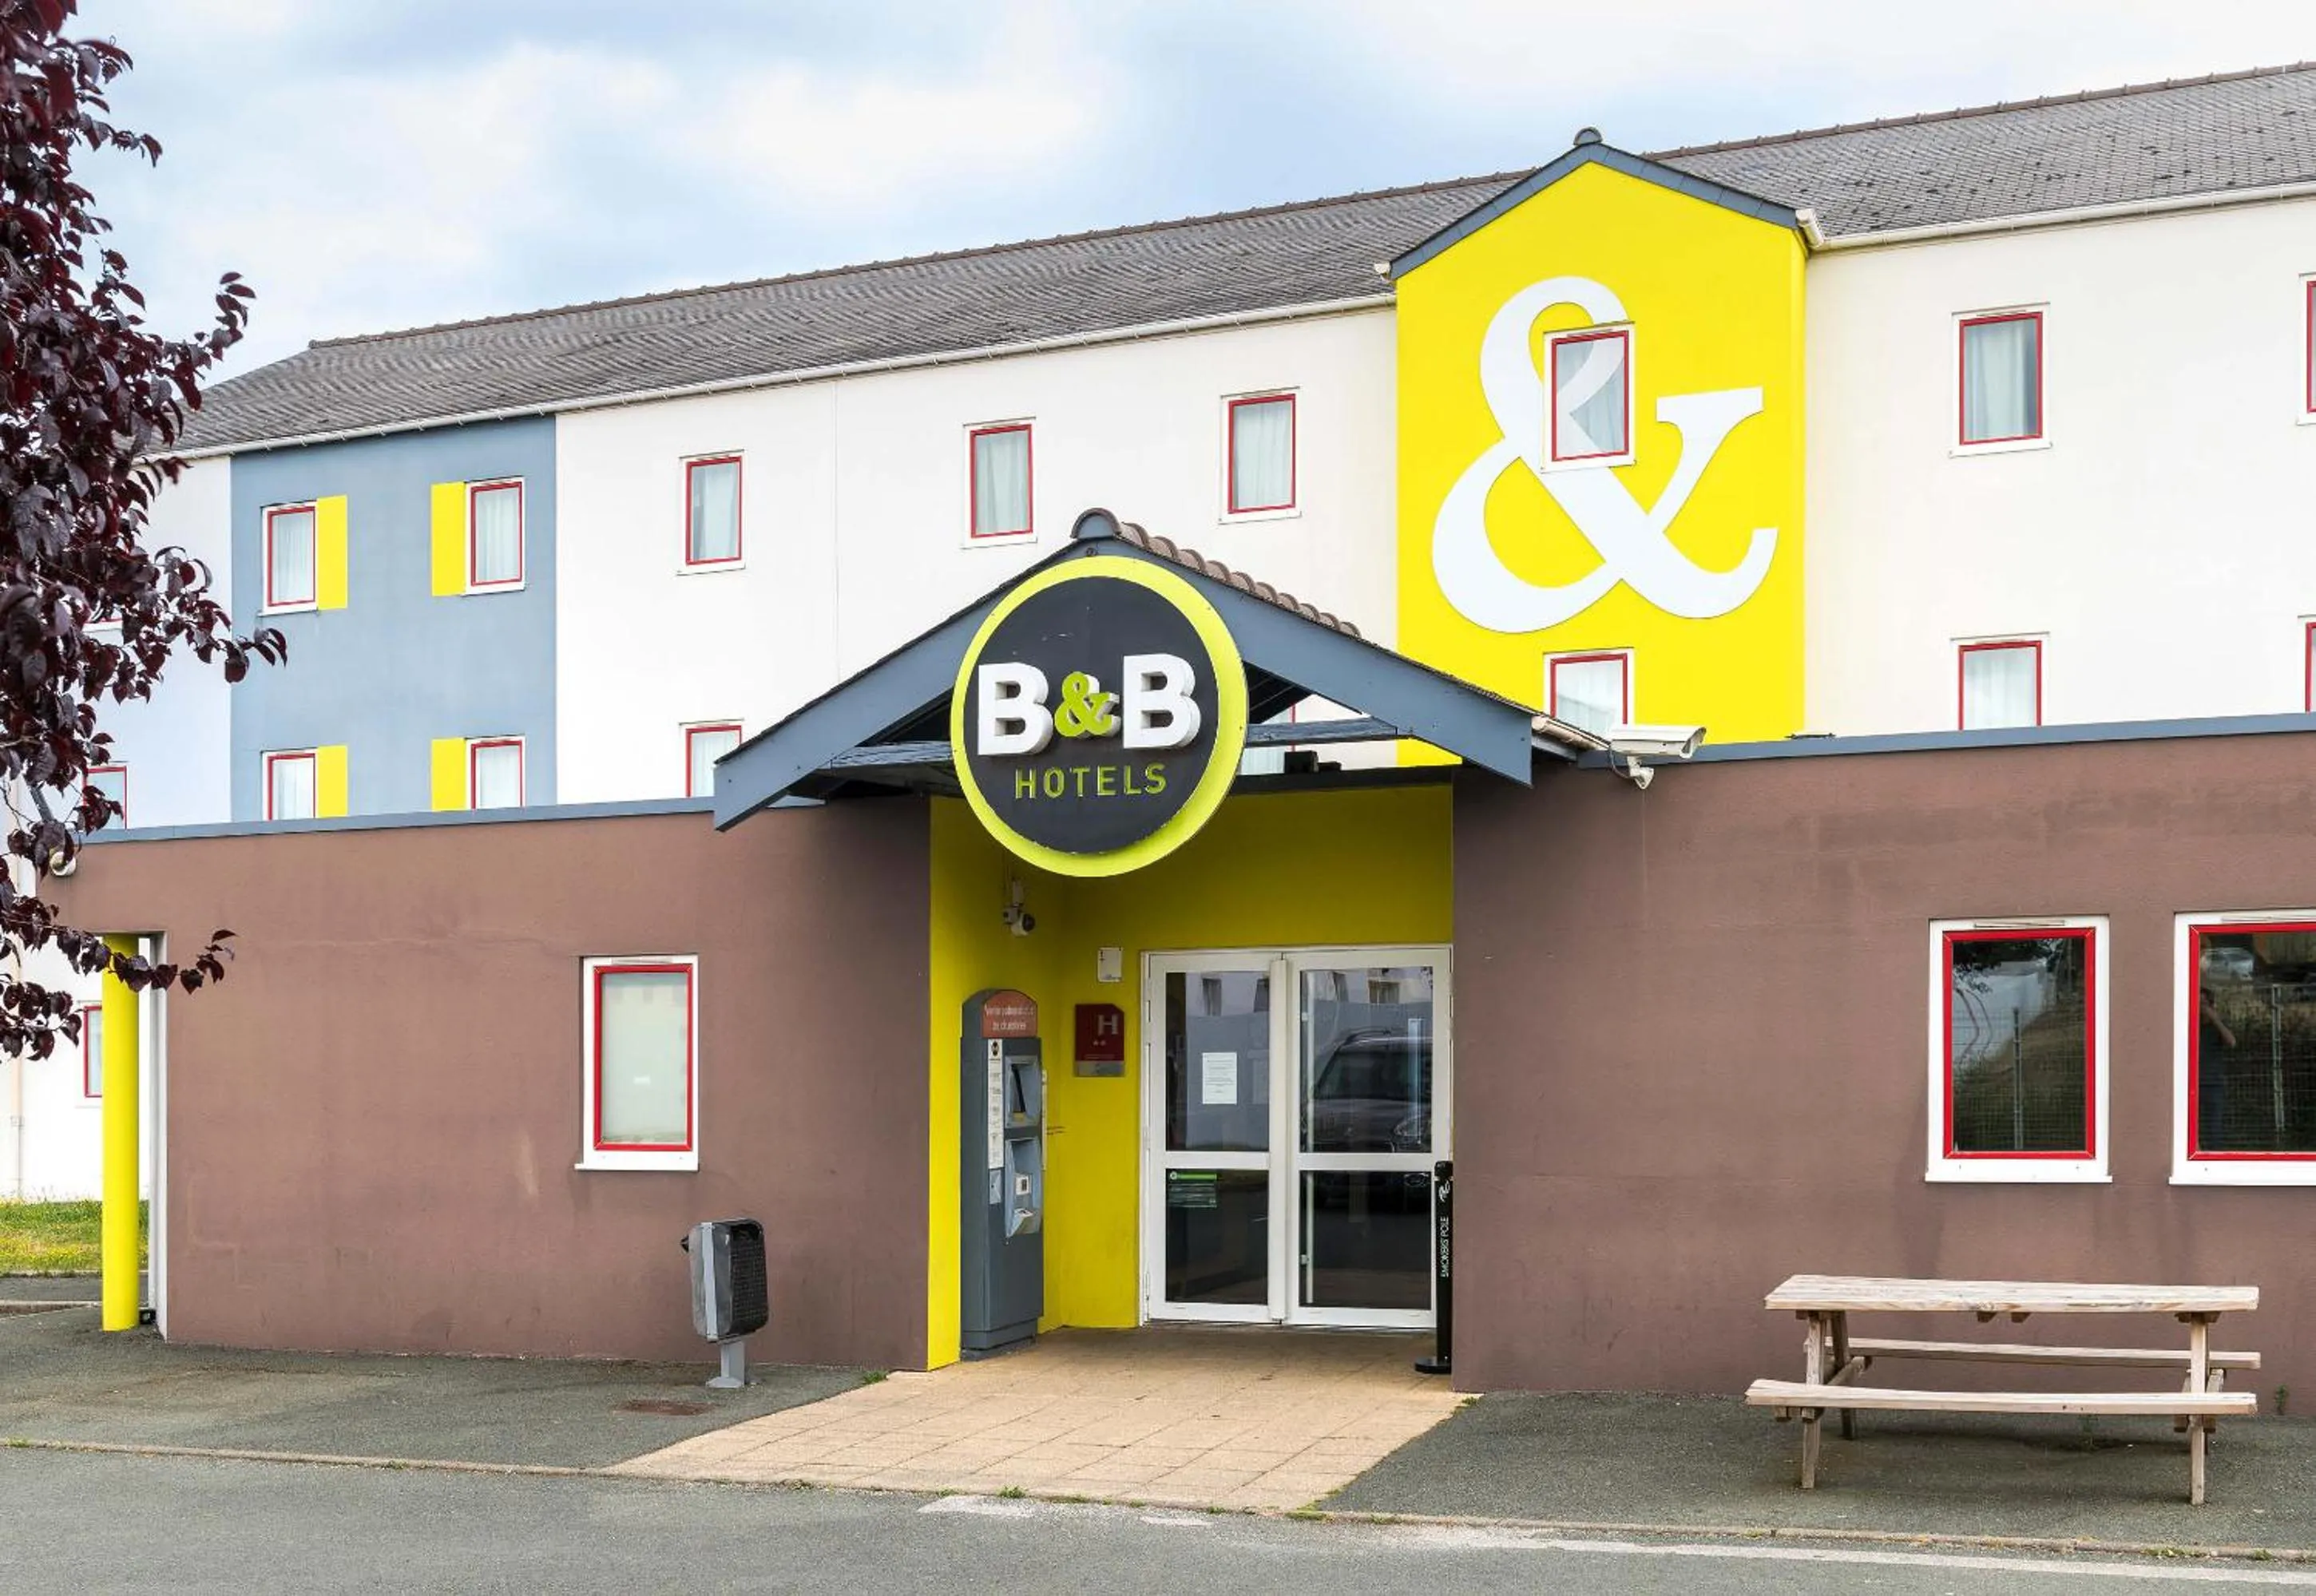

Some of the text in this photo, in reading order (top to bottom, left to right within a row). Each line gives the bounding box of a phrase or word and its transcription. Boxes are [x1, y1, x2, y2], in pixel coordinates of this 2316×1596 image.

[1432, 275, 1779, 634] &
[978, 653, 1202, 756] B&B
[1015, 763, 1168, 799] HOTELS
[1098, 1014, 1118, 1036] H
[1440, 1216, 1449, 1237] POLE
